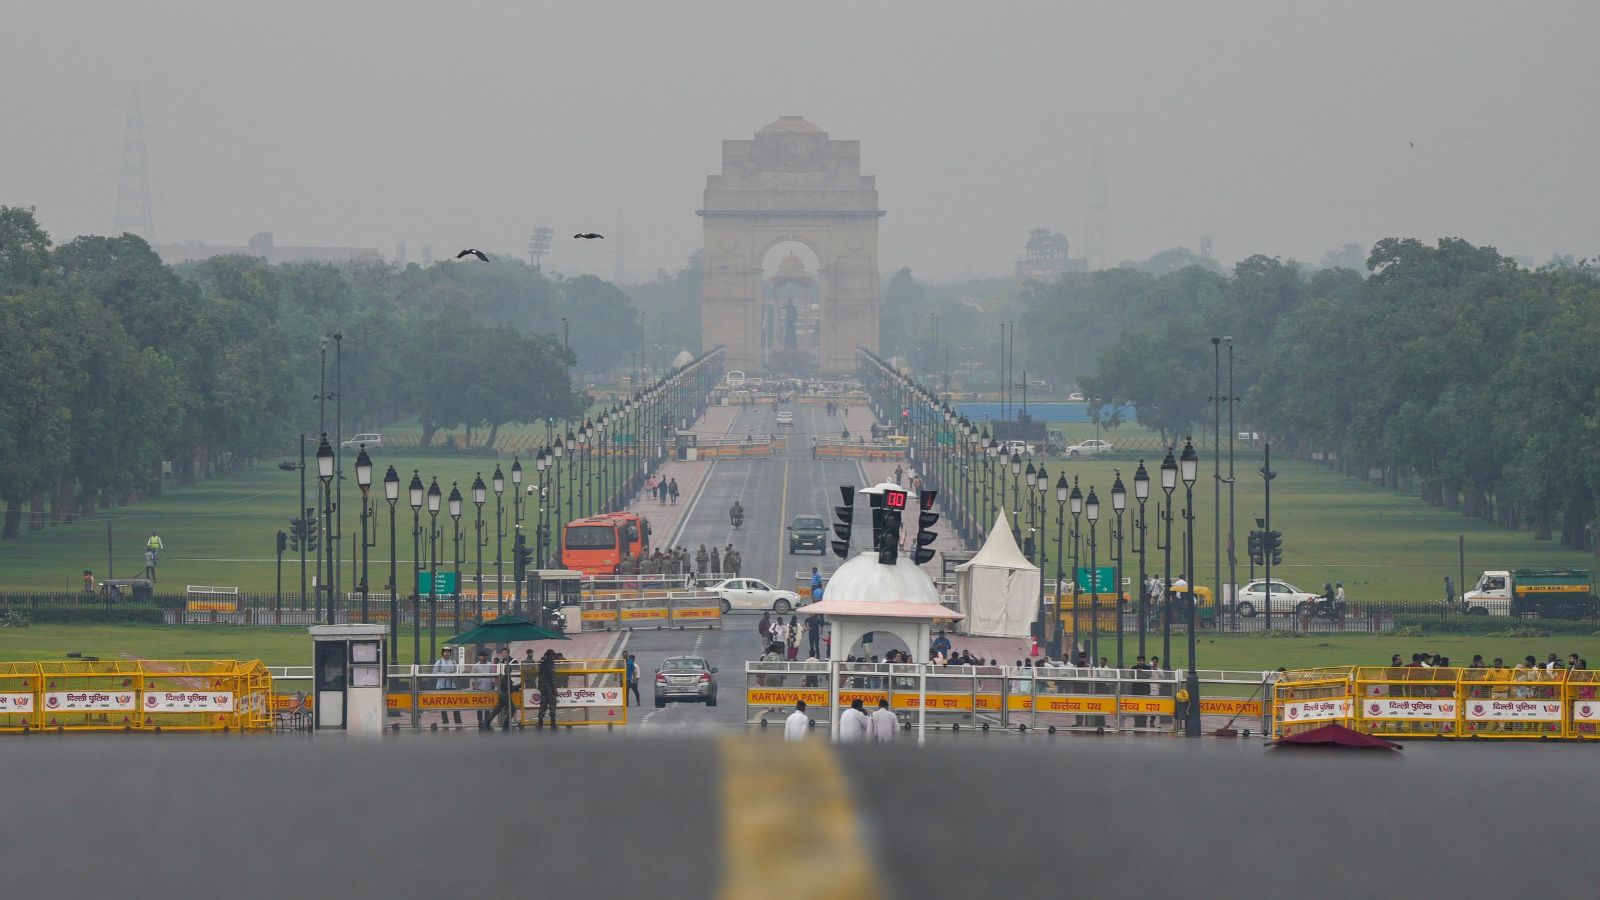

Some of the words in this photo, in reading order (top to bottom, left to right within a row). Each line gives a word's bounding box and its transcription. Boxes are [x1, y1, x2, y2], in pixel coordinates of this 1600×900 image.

[66, 693, 87, 702] दिल्ली
[88, 693, 109, 704] पुलिस
[165, 693, 186, 702] दिल्ली
[187, 693, 207, 704] पुलिस
[574, 689, 596, 700] पुलिस
[752, 692, 799, 702] KARTAVYA
[802, 693, 824, 702] PATH
[422, 696, 470, 706] KARTAVYA
[472, 696, 496, 705] PATH
[1389, 700, 1410, 710] दिल्ली
[1411, 701, 1432, 712] पुलिस
[1087, 702, 1101, 711] पथ
[1146, 703, 1160, 712] पथ
[1200, 702, 1233, 712] RTAVYA
[1236, 703, 1258, 712] PATH
[1492, 702, 1514, 710] दिल्ली
[1515, 702, 1536, 712] पुलिस
